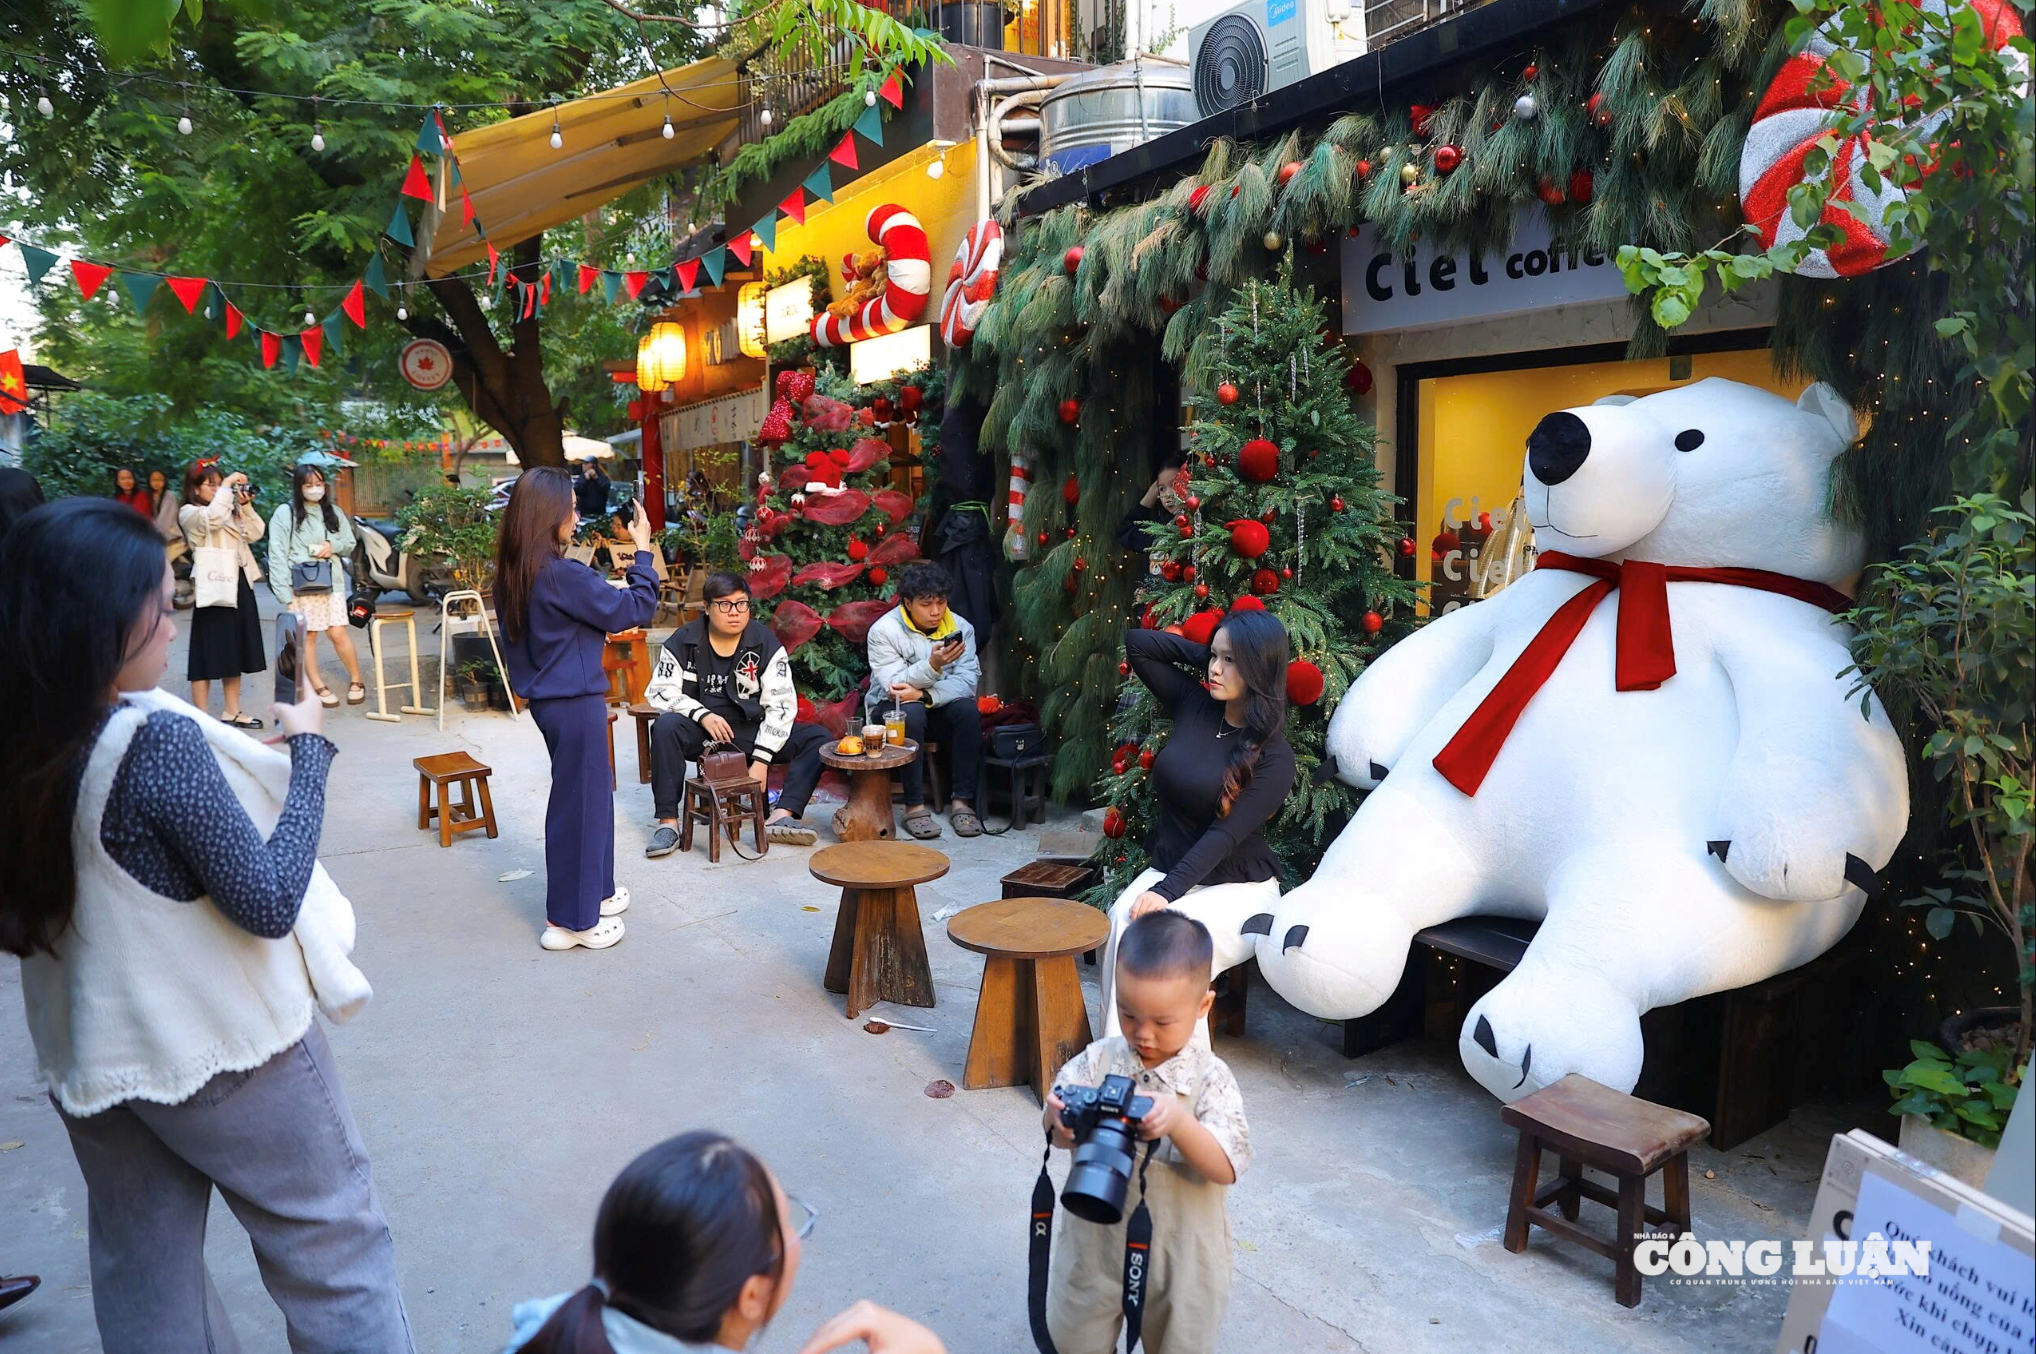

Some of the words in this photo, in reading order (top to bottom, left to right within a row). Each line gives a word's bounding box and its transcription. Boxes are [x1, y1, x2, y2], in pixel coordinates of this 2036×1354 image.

[1269, 1, 1295, 19] Midea
[1366, 243, 1489, 301] Ciel
[1444, 495, 1527, 531] Ciel
[1128, 1253, 1144, 1307] SONY
[1986, 1280, 2016, 1305] vui
[1894, 1307, 1926, 1338] Xin
[1918, 1293, 1948, 1323] khi
